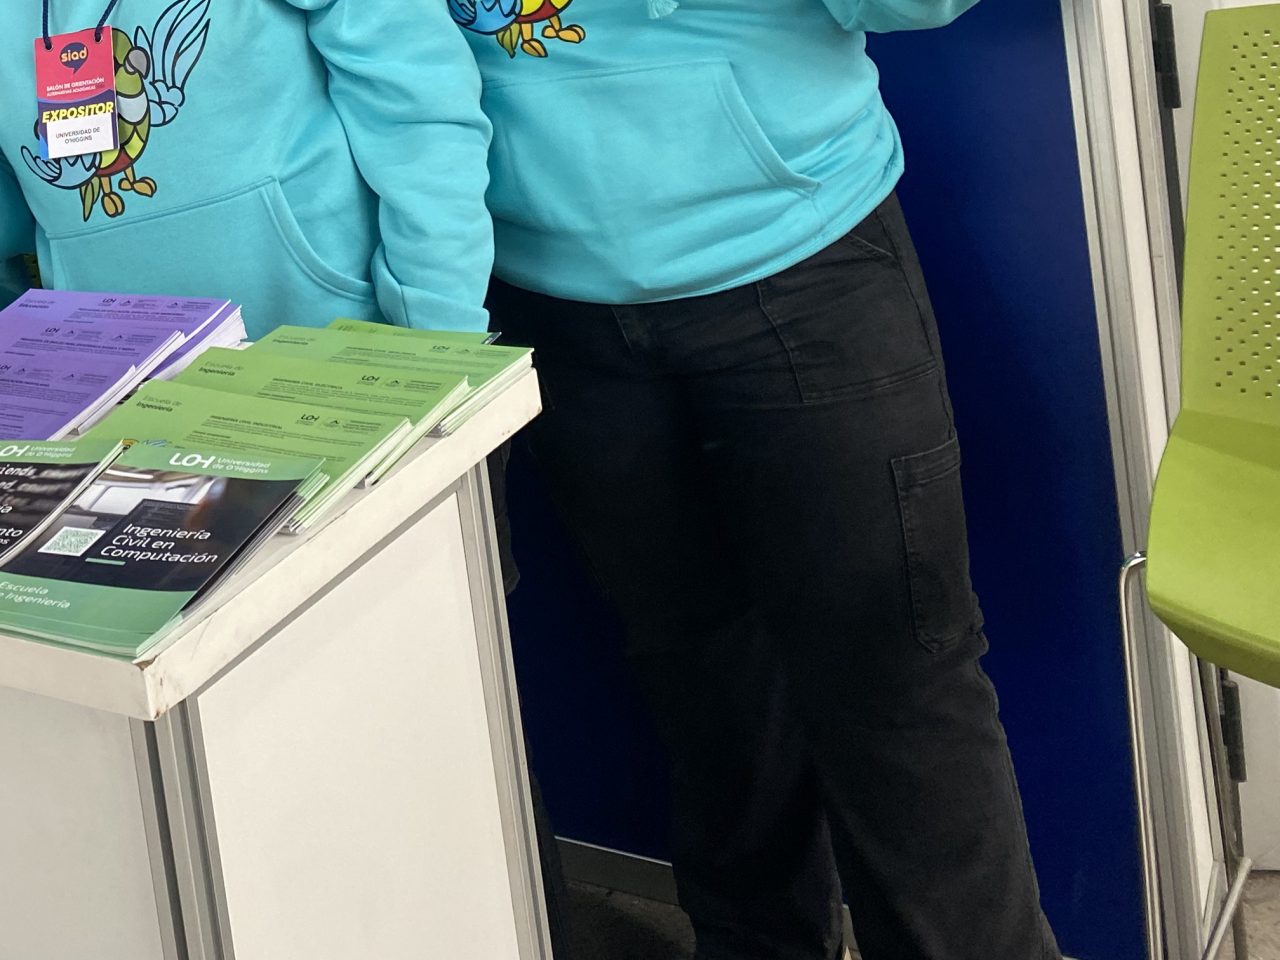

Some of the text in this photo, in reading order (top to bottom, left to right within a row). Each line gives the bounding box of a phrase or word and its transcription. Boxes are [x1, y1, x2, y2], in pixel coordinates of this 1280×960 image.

[61, 47, 87, 62] siad
[42, 101, 114, 123] EXPOSITOR
[56, 126, 100, 139] UNIVERSIDAD DE
[212, 461, 224, 470] de
[216, 456, 271, 468] Universidad
[122, 523, 212, 541] Ingeniería
[112, 535, 175, 550] Civil en
[100, 546, 218, 564] Computación
[5, 592, 71, 609] Ingeniería
